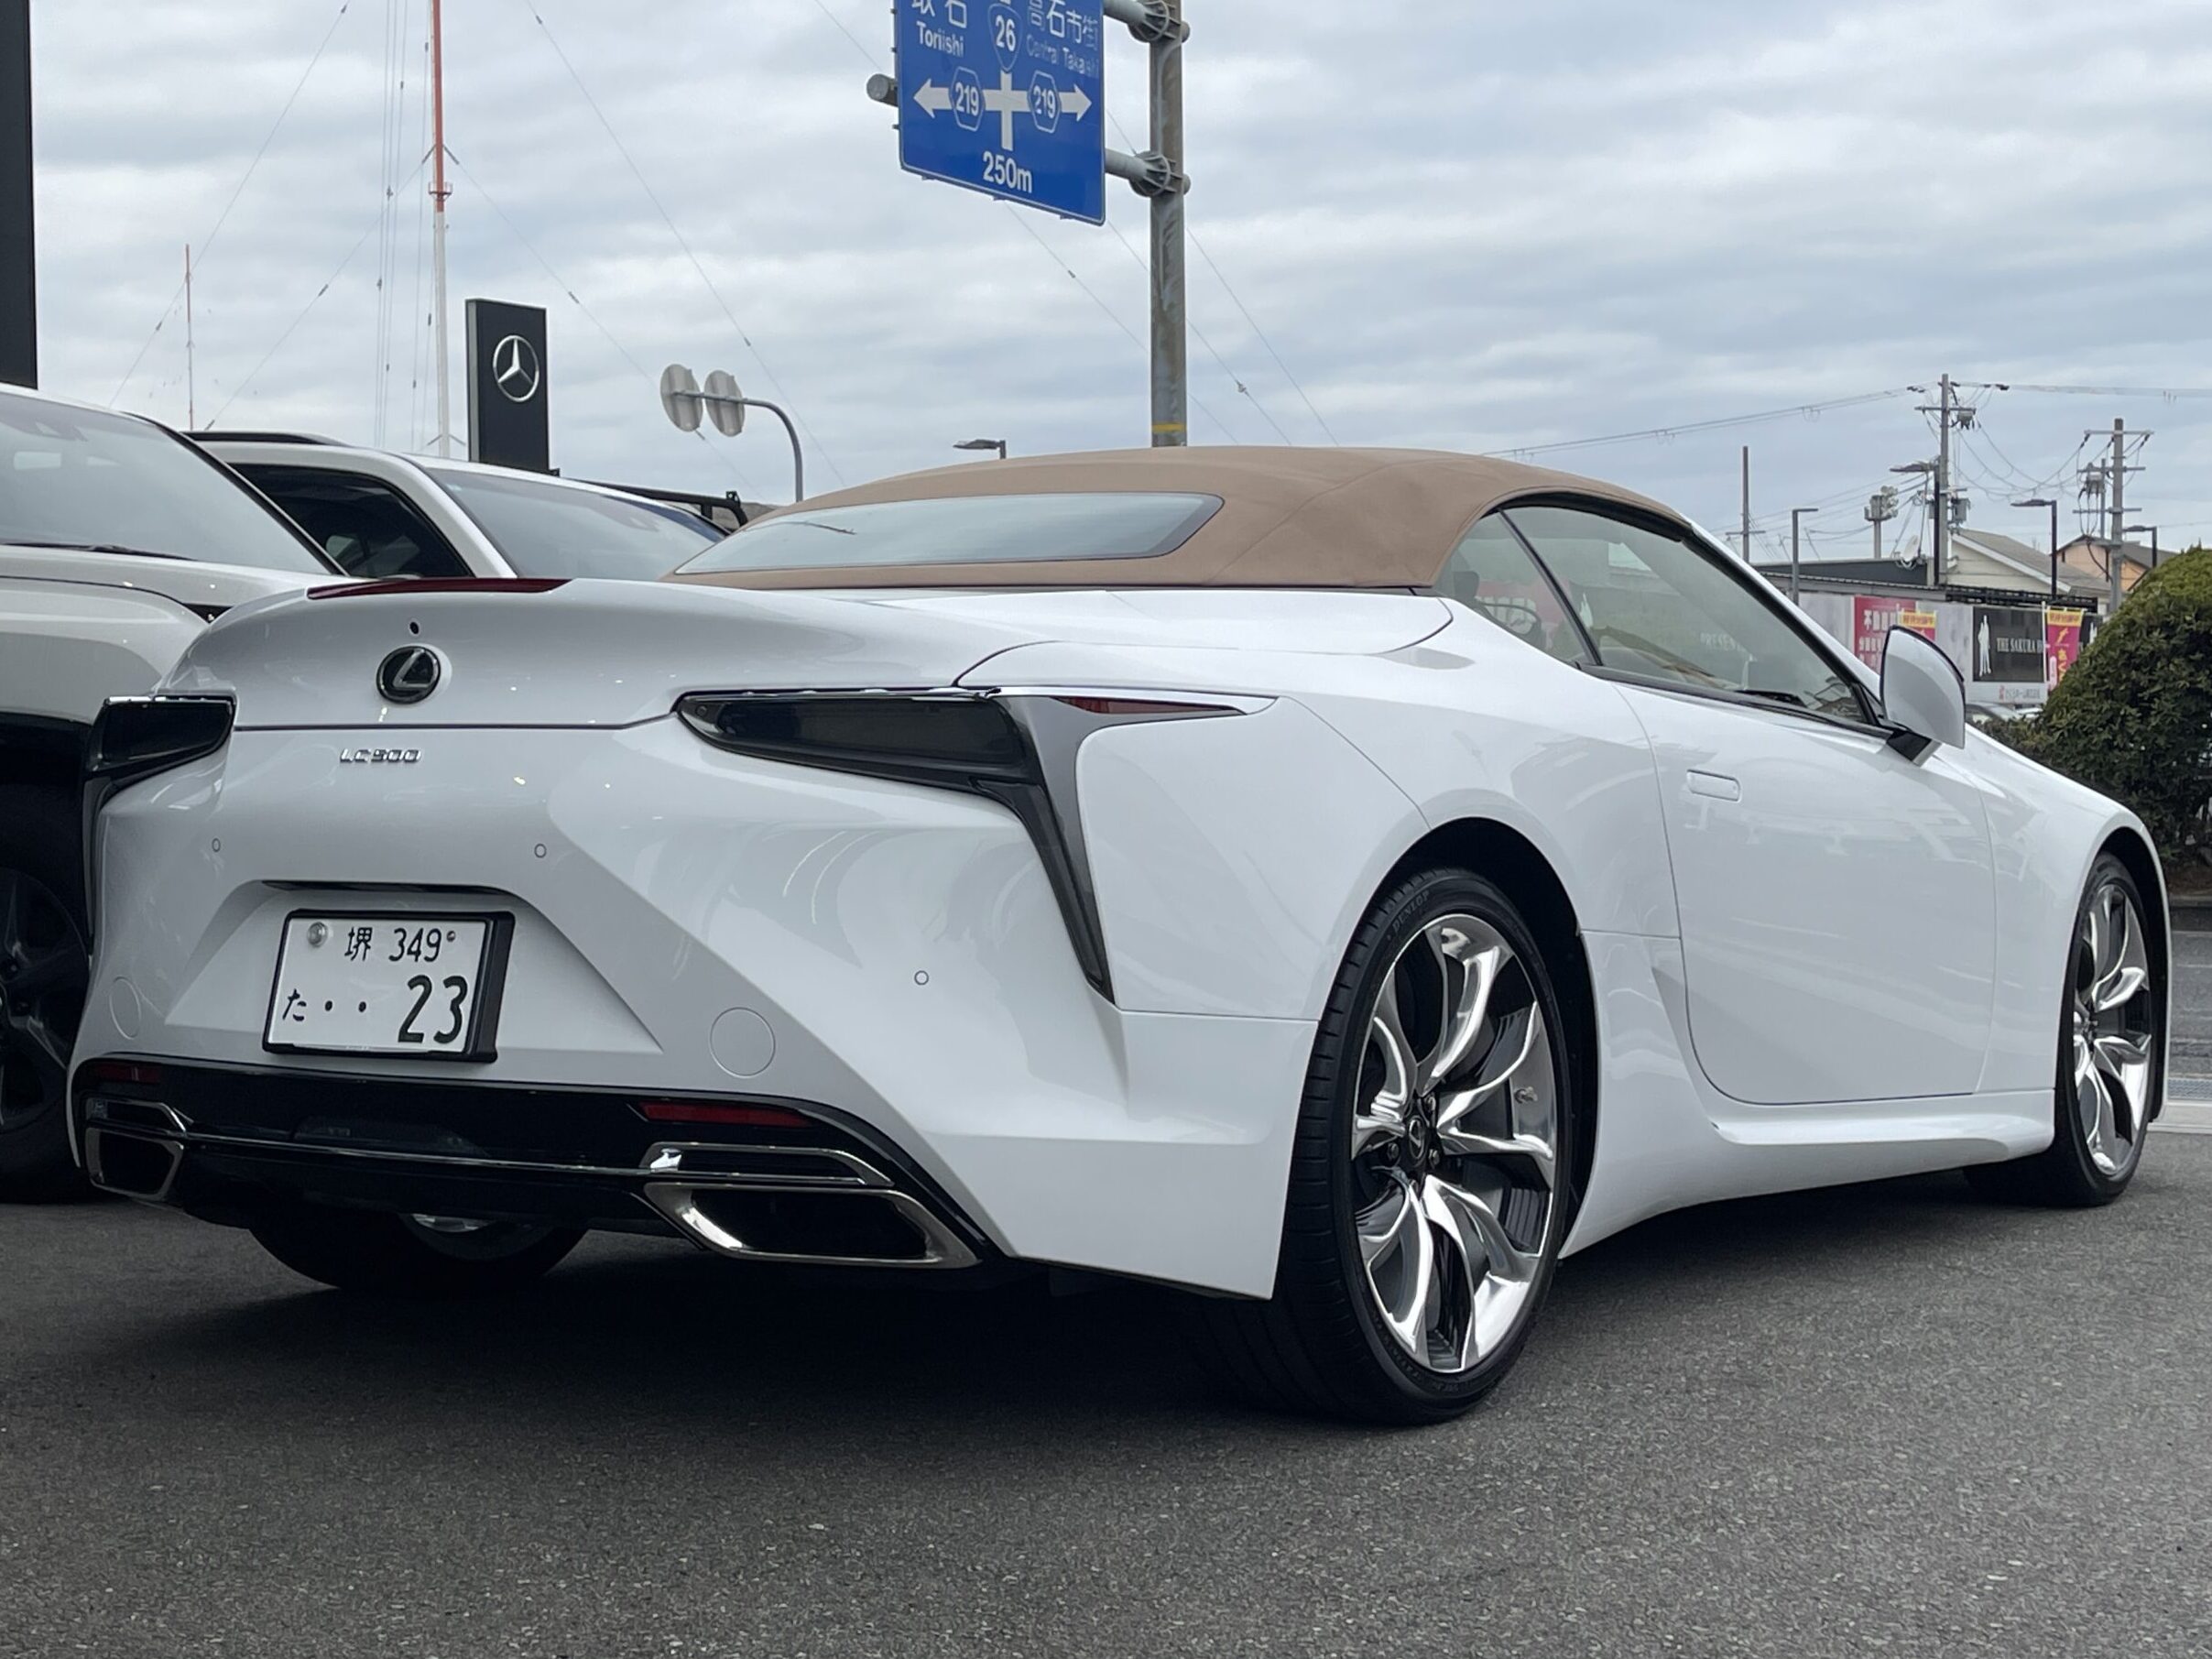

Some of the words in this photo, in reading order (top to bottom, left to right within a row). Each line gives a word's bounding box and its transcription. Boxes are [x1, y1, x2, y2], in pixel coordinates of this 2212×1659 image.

[916, 20, 964, 58] Toriishi
[995, 15, 1016, 51] 26
[955, 82, 979, 116] 219
[1033, 85, 1055, 119] 219
[983, 150, 1032, 193] 250m
[344, 926, 373, 962] 堺
[388, 927, 442, 963] 349
[282, 988, 307, 1021] た
[398, 974, 468, 1044] 23
